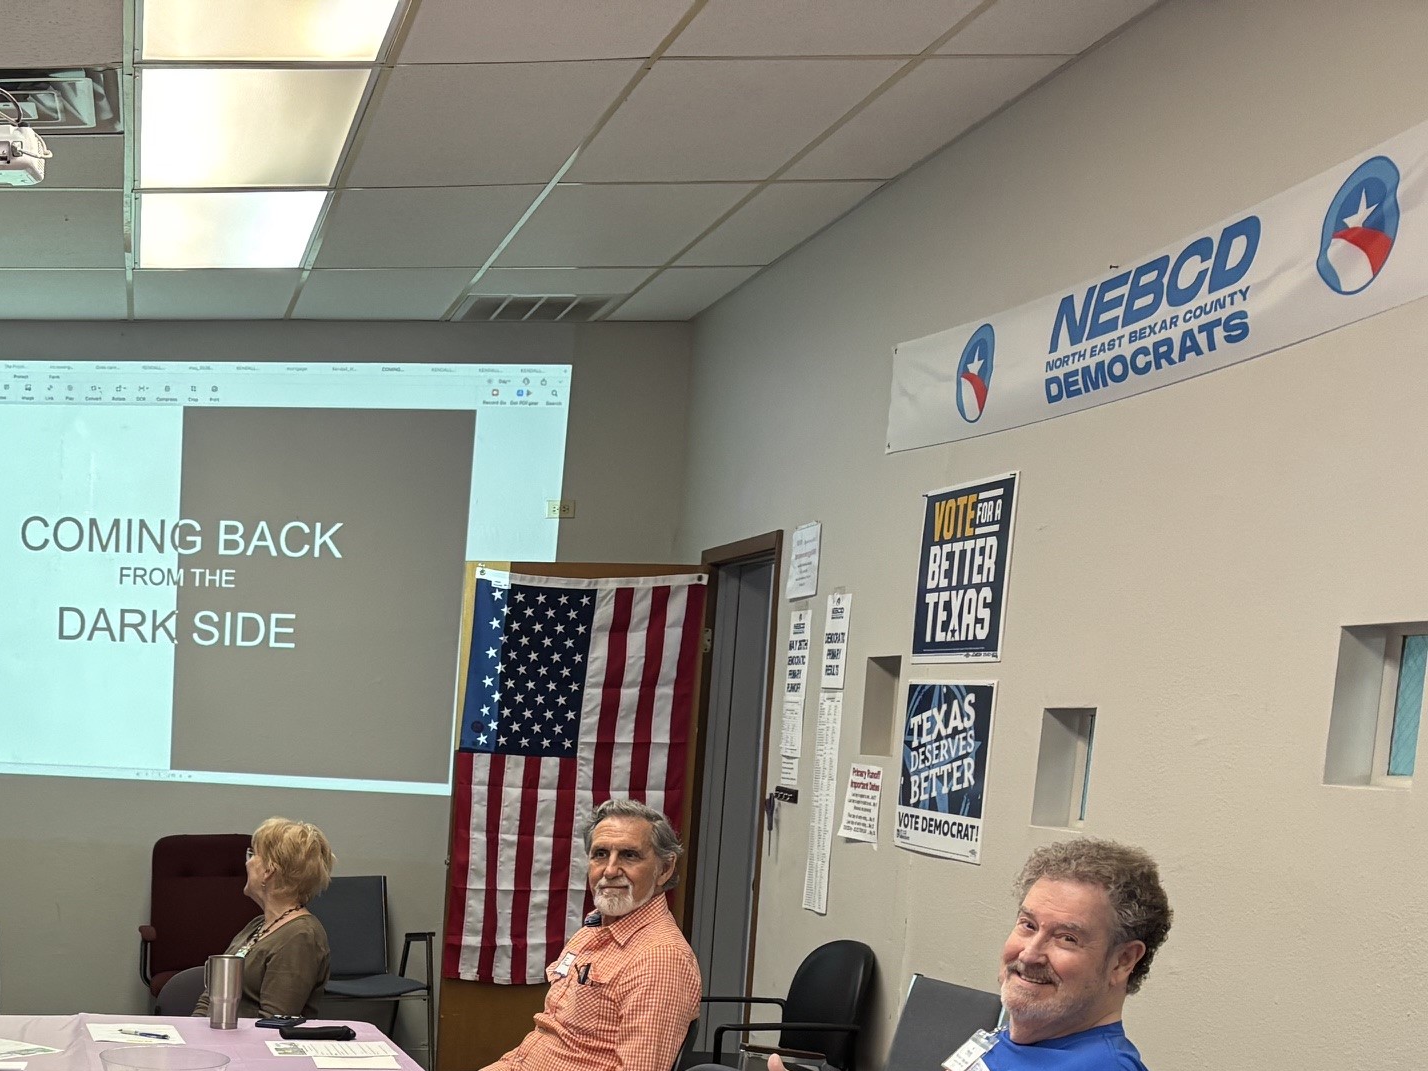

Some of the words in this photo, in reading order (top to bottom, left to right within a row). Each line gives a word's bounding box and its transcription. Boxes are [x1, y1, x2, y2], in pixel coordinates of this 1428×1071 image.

[1048, 215, 1262, 356] NEBCD
[1045, 348, 1087, 373] NORTH
[1089, 334, 1125, 358] EAST
[1128, 315, 1179, 345] BEXAR
[1182, 285, 1251, 323] COUNTY
[1045, 310, 1250, 405] DEMOCRATS
[21, 515, 203, 556] COMING
[218, 519, 344, 559] BACK
[933, 493, 978, 542] VOTE
[976, 500, 993, 525] FOR
[995, 499, 1002, 521] A
[119, 566, 183, 587] FROM
[191, 568, 236, 588] THE
[926, 535, 998, 590] BETTER
[58, 606, 179, 645] DARK
[192, 610, 296, 648] SIDE
[925, 586, 992, 643] TEXAS
[910, 693, 976, 748] TEXAS
[910, 730, 975, 773] DESERVES
[910, 757, 975, 804] BETTER
[898, 811, 920, 831] VOTE
[921, 816, 979, 842] DEMOCRAT!
